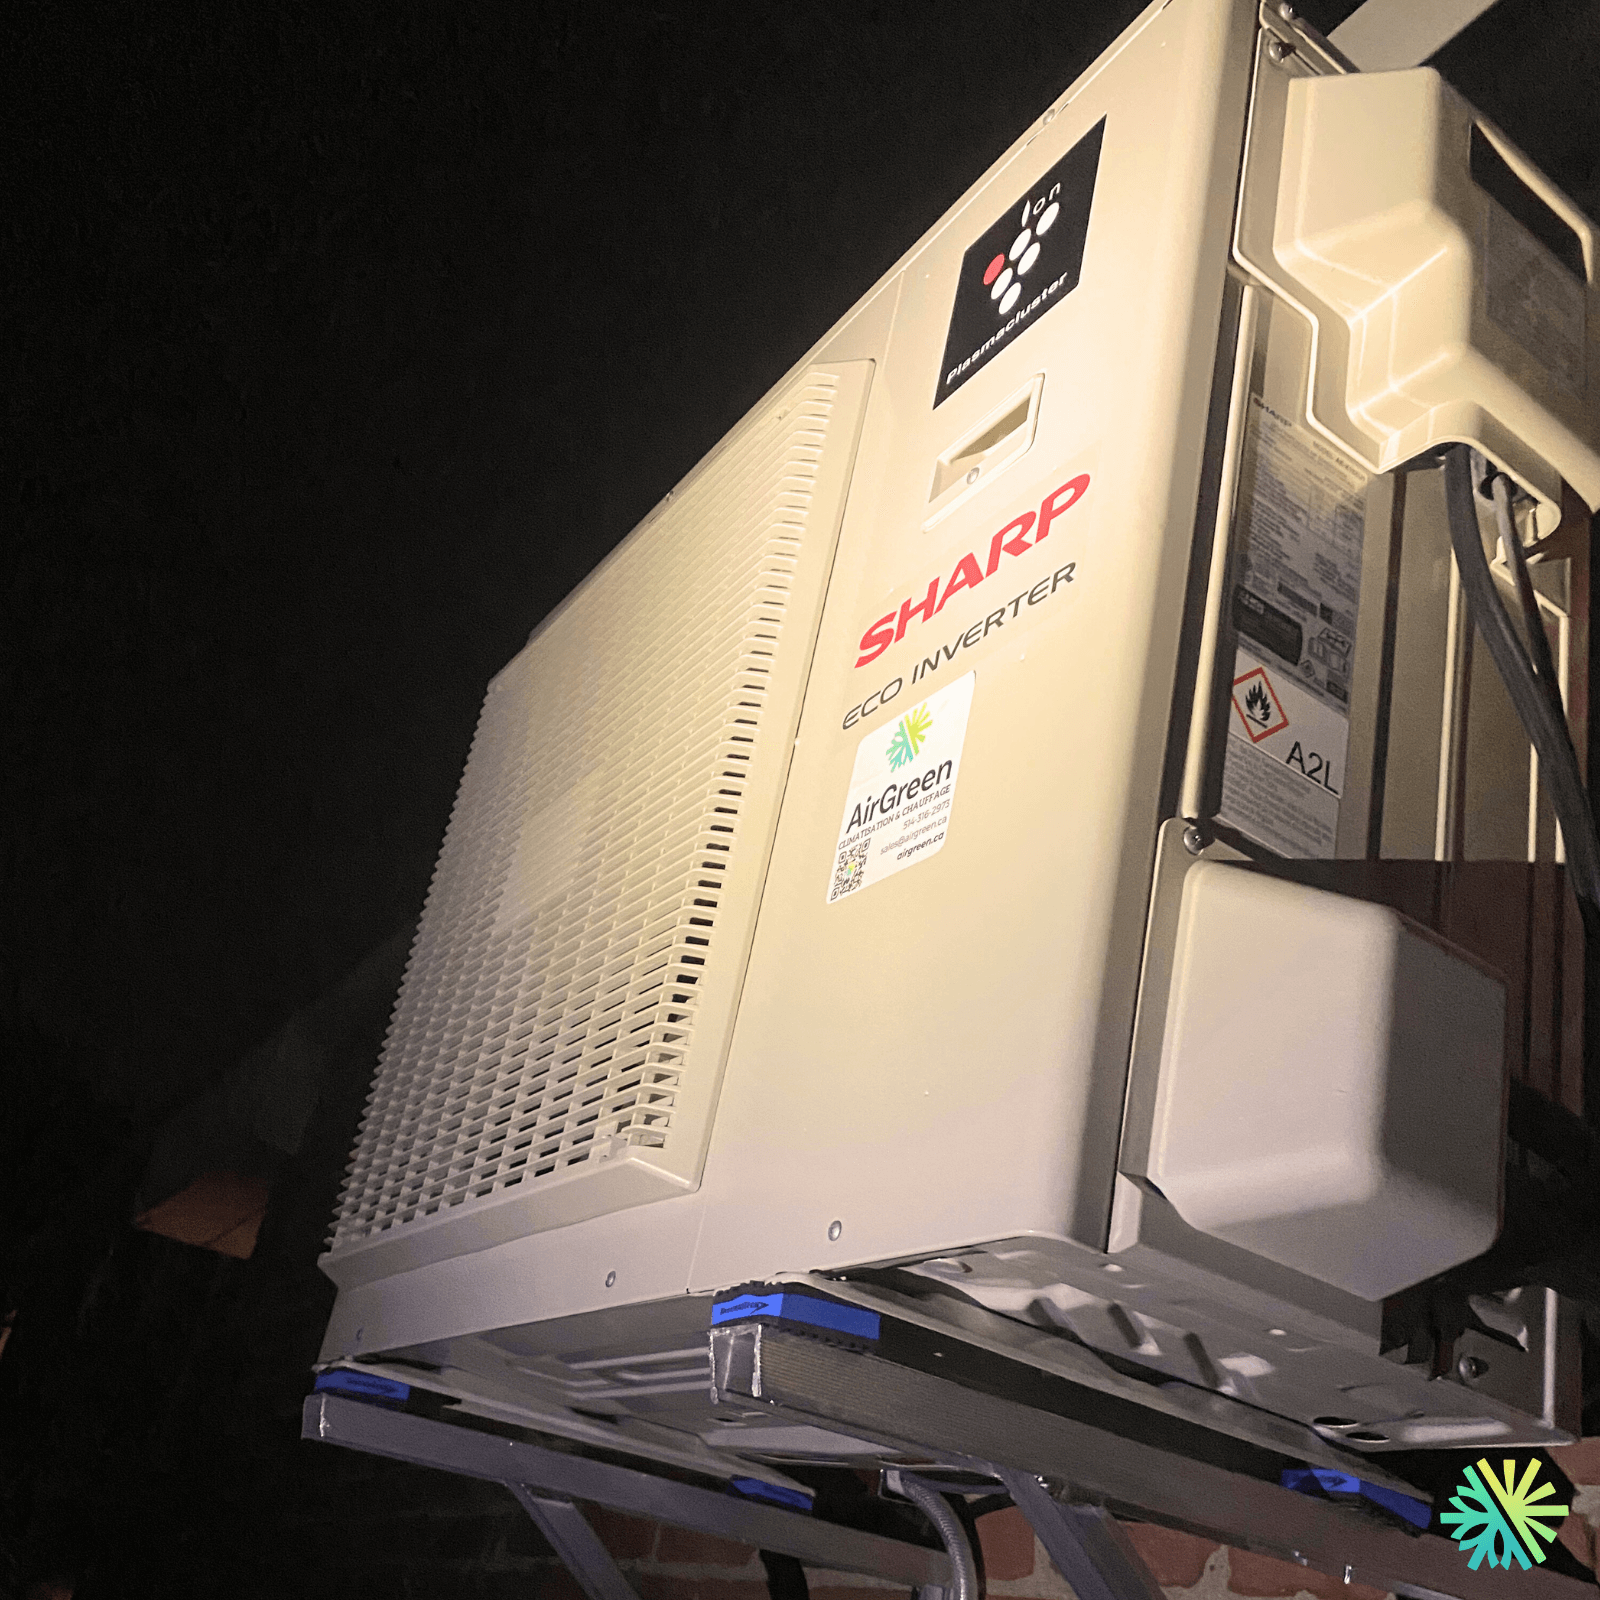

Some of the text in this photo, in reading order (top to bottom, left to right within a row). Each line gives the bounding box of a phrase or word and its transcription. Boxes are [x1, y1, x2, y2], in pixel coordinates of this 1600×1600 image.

[1021, 182, 1061, 227] Ion
[946, 271, 1068, 385] Plasmacluster
[854, 473, 1091, 669] SHARP
[842, 561, 1076, 730] ECO INVERTER
[846, 759, 953, 834] AirGreen
[1286, 741, 1339, 795] A2L
[838, 783, 951, 850] CLIMATISATION & CHAUFFAGE
[880, 816, 948, 855] sales@airgreen.ca
[896, 831, 945, 861] airgreen.ca
